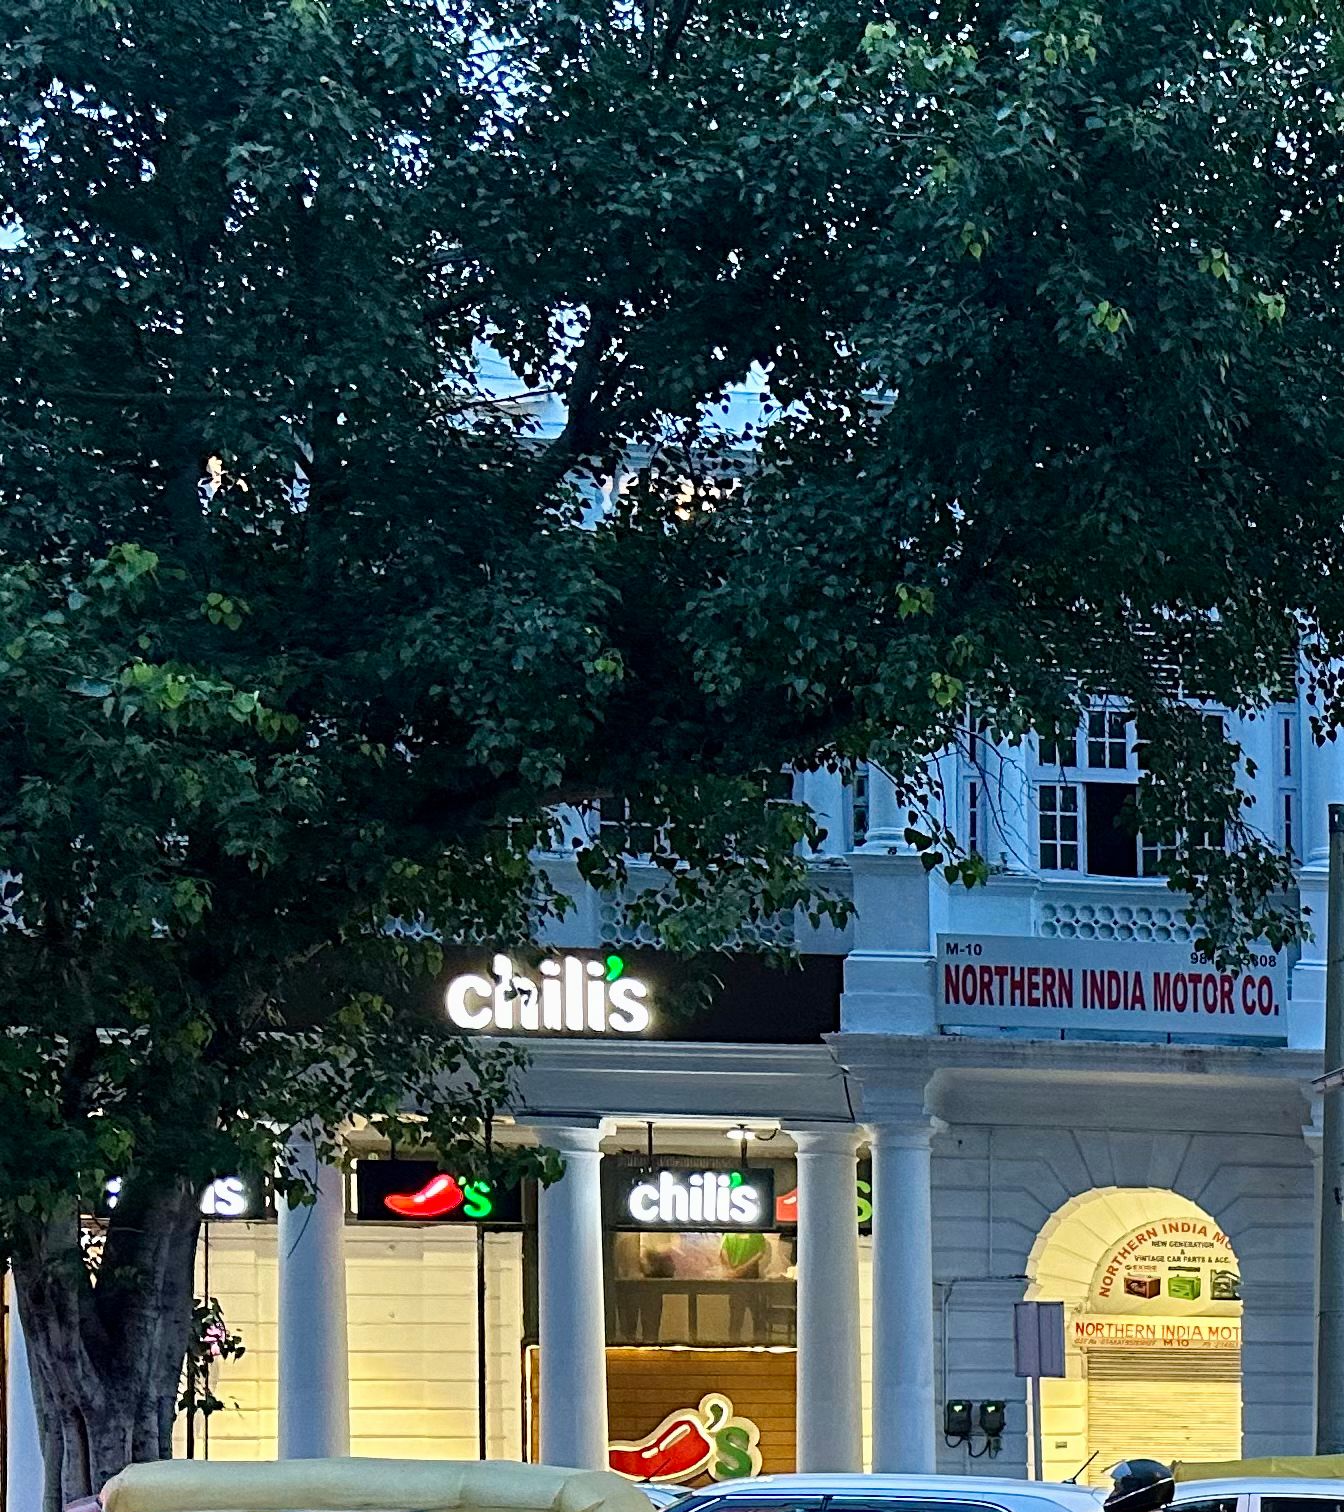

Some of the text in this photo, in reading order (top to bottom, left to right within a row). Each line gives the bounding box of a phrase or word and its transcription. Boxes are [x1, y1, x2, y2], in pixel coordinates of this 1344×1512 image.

[944, 942, 983, 957] M-10
[446, 953, 651, 1033] chili's
[943, 963, 1281, 1016] NORTHERN INDIA MOTOR CO.
[628, 1170, 759, 1223] chili's
[1098, 1227, 1159, 1298] NORTHERN
[1161, 1222, 1208, 1237] INDIA
[1075, 1321, 1156, 1340] NORTHERN
[1161, 1323, 1204, 1341] INDIA
